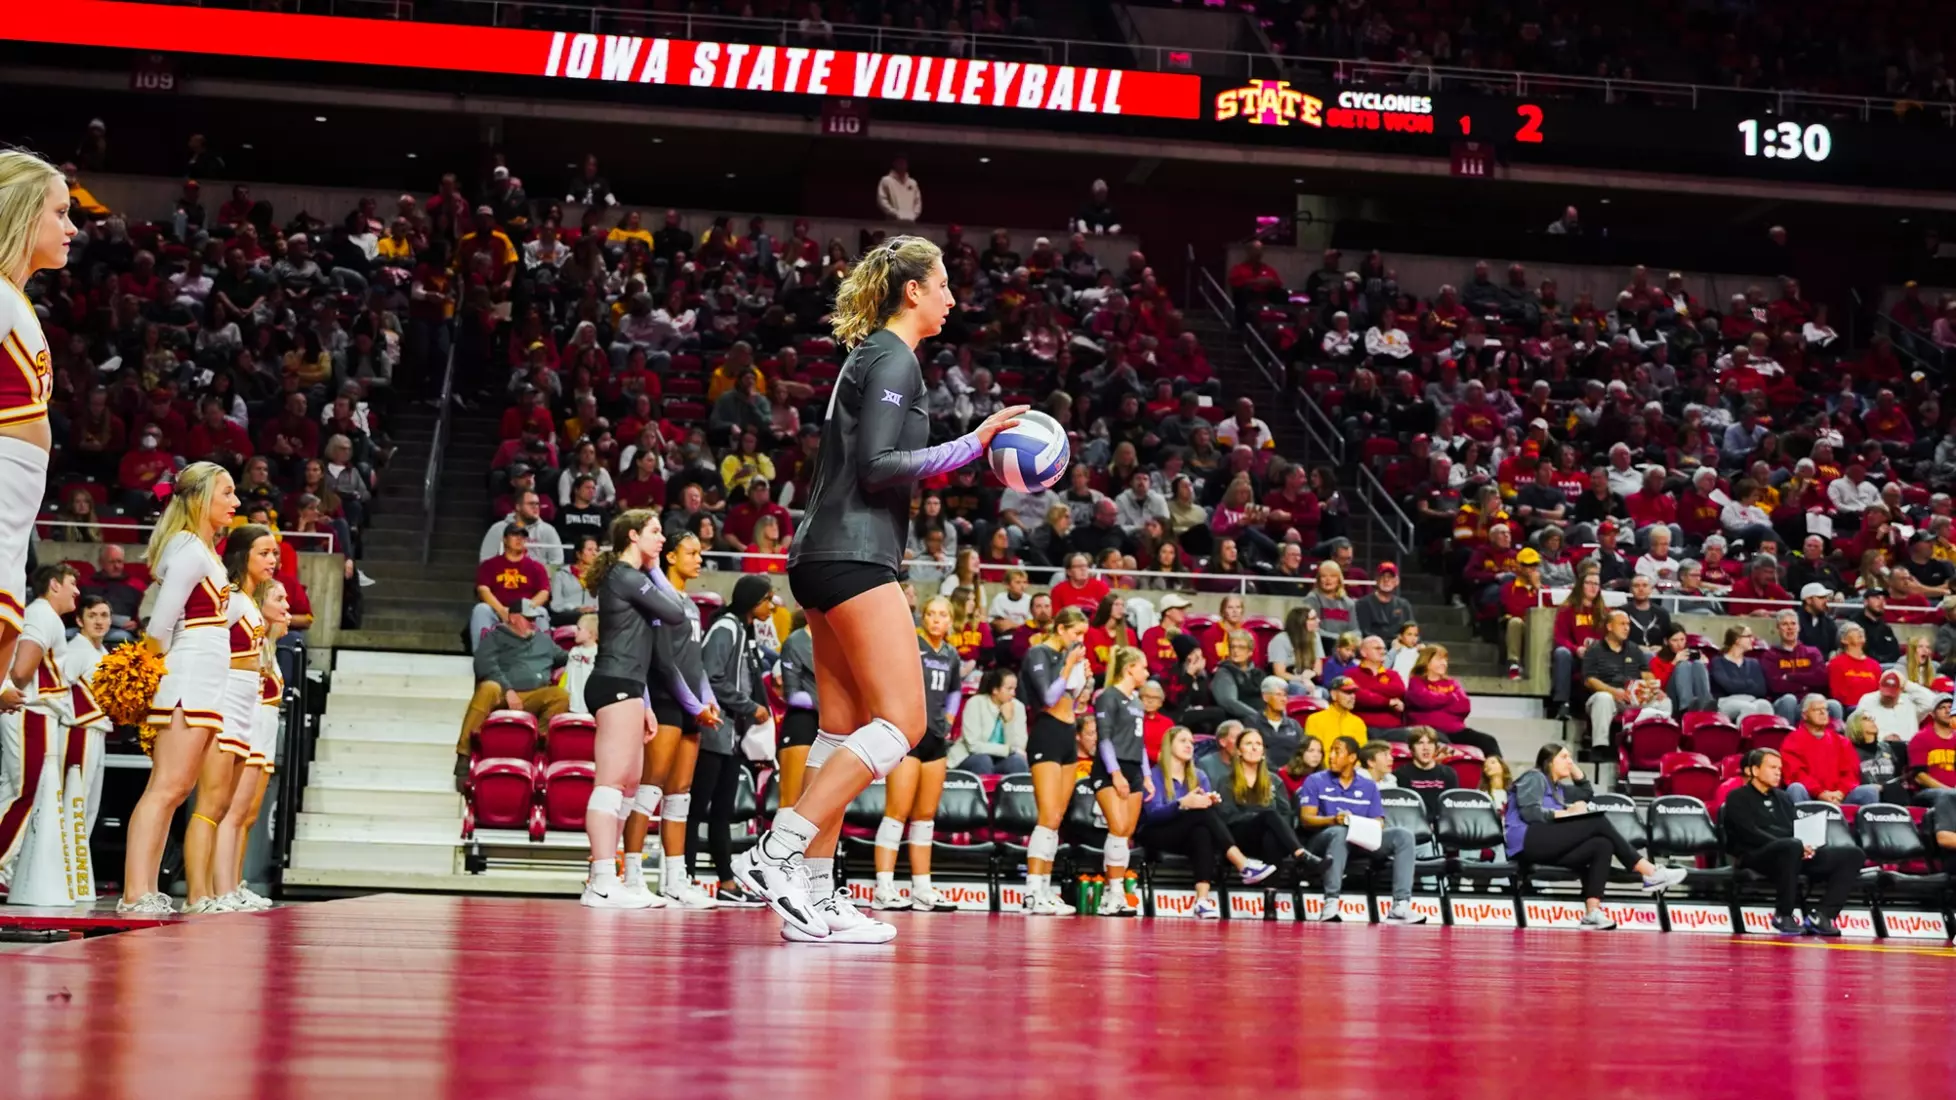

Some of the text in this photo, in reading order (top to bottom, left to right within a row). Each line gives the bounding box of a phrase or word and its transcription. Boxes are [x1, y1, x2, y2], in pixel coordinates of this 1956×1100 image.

[136, 72, 174, 90] 109
[545, 31, 1122, 114] IOWA STATE VOLLEYBALL
[1215, 84, 1323, 127] STATE
[1338, 91, 1433, 113] CYCLONES
[830, 116, 860, 133] 110
[1326, 108, 1471, 135] SETS WON 1
[1515, 104, 1544, 143] 2
[1738, 119, 1832, 162] 1:30
[1460, 158, 1484, 175] 111
[931, 669, 945, 691] 11
[72, 797, 90, 896] CYCLONES
[1454, 904, 1512, 922] HyVee
[1528, 905, 1585, 924] HyVee
[1671, 910, 1728, 928] HyVee
[1887, 916, 1942, 934] HyVee
